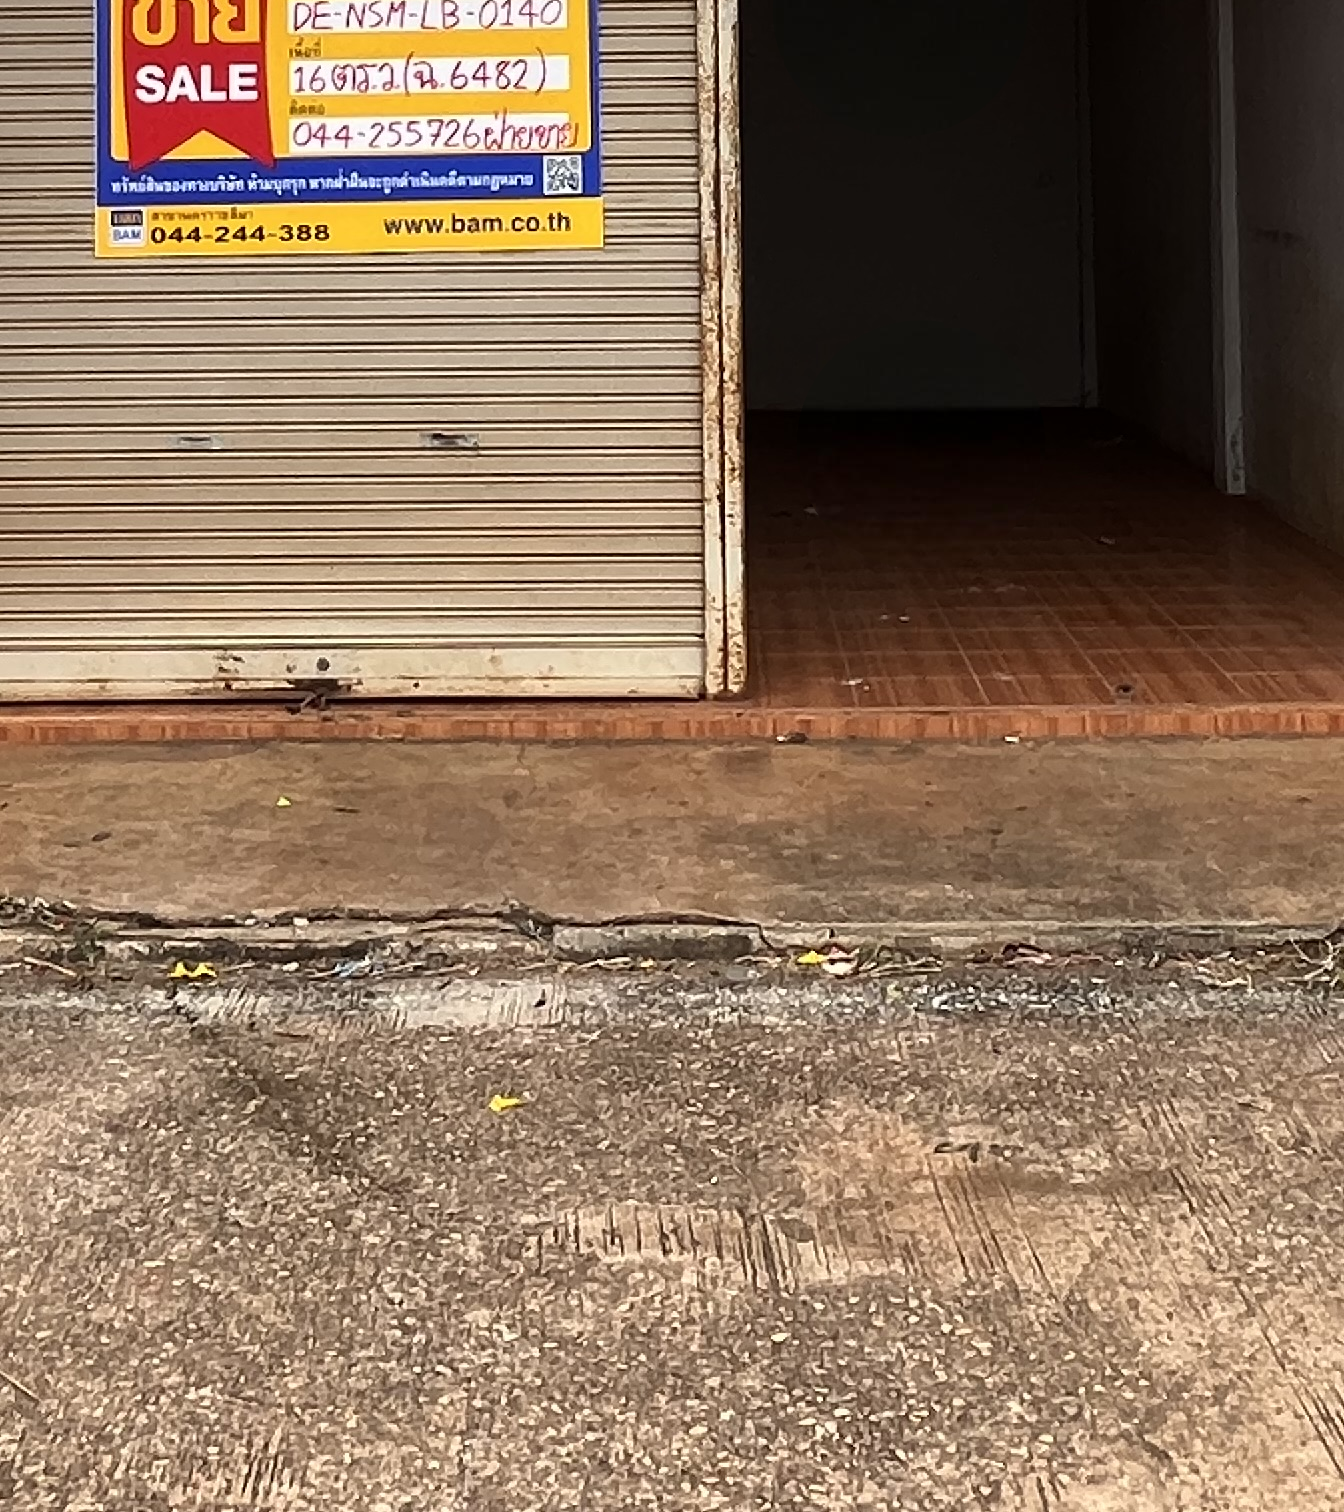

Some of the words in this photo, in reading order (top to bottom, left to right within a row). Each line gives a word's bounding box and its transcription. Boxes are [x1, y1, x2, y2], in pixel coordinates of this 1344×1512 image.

[134, 64, 259, 103] SALE
[113, 230, 141, 240] BAM
[151, 224, 330, 244] 044-244-388
[383, 211, 571, 235] www.bam.co.th
